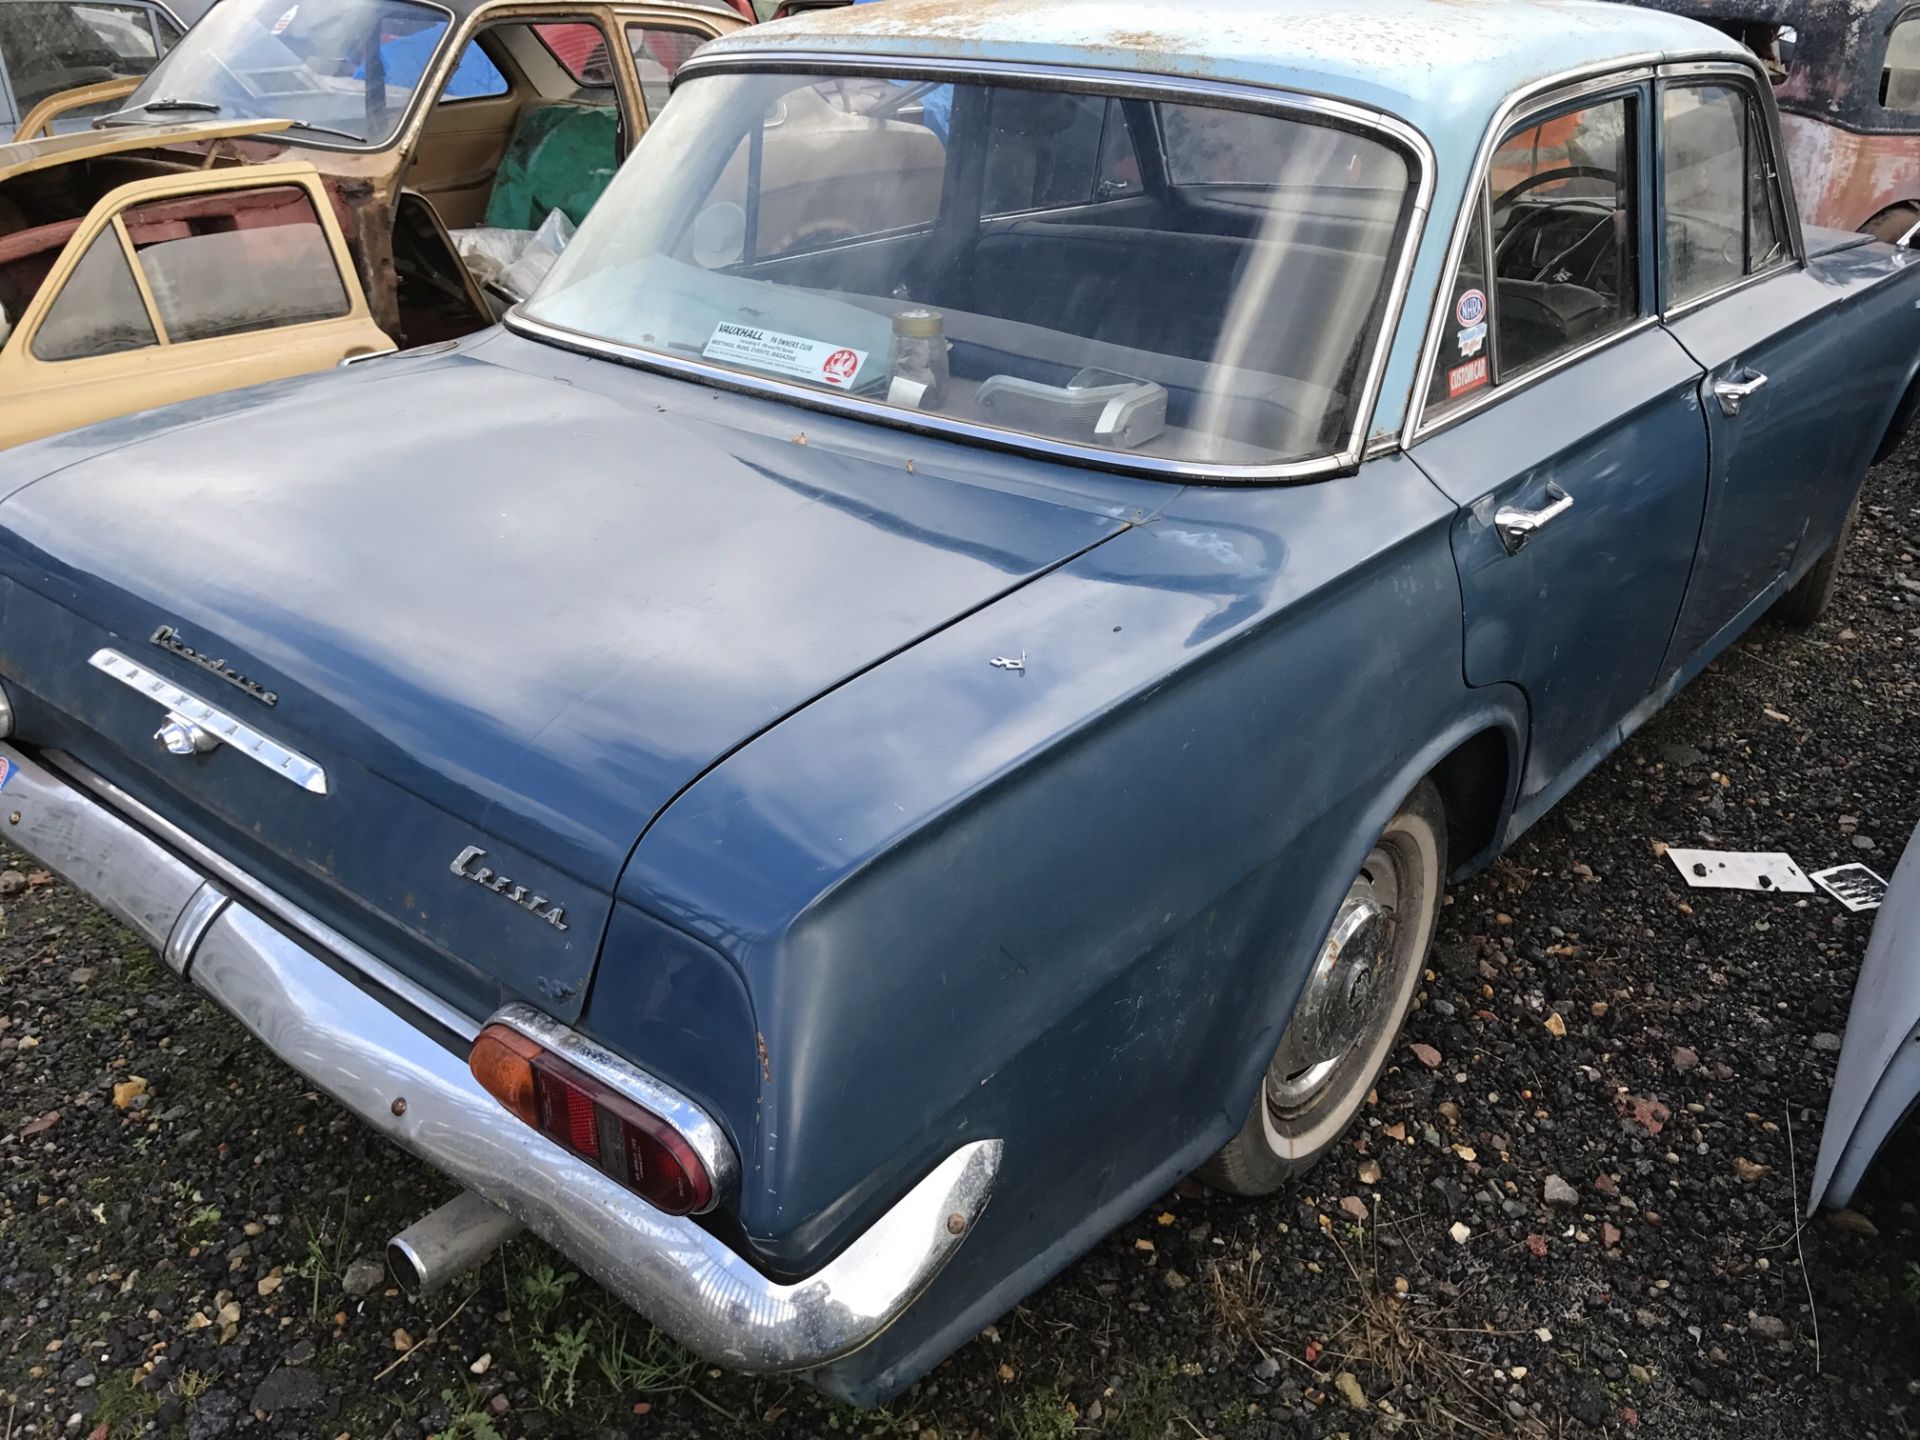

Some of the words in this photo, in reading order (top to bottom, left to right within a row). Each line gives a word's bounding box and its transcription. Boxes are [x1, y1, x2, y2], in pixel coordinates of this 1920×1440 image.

[1461, 297, 1482, 319] NHRA
[718, 323, 764, 341] VAUXHALL
[777, 338, 800, 349] OWNERS
[799, 343, 814, 351] CLUB
[103, 656, 293, 769] VAUXHALL
